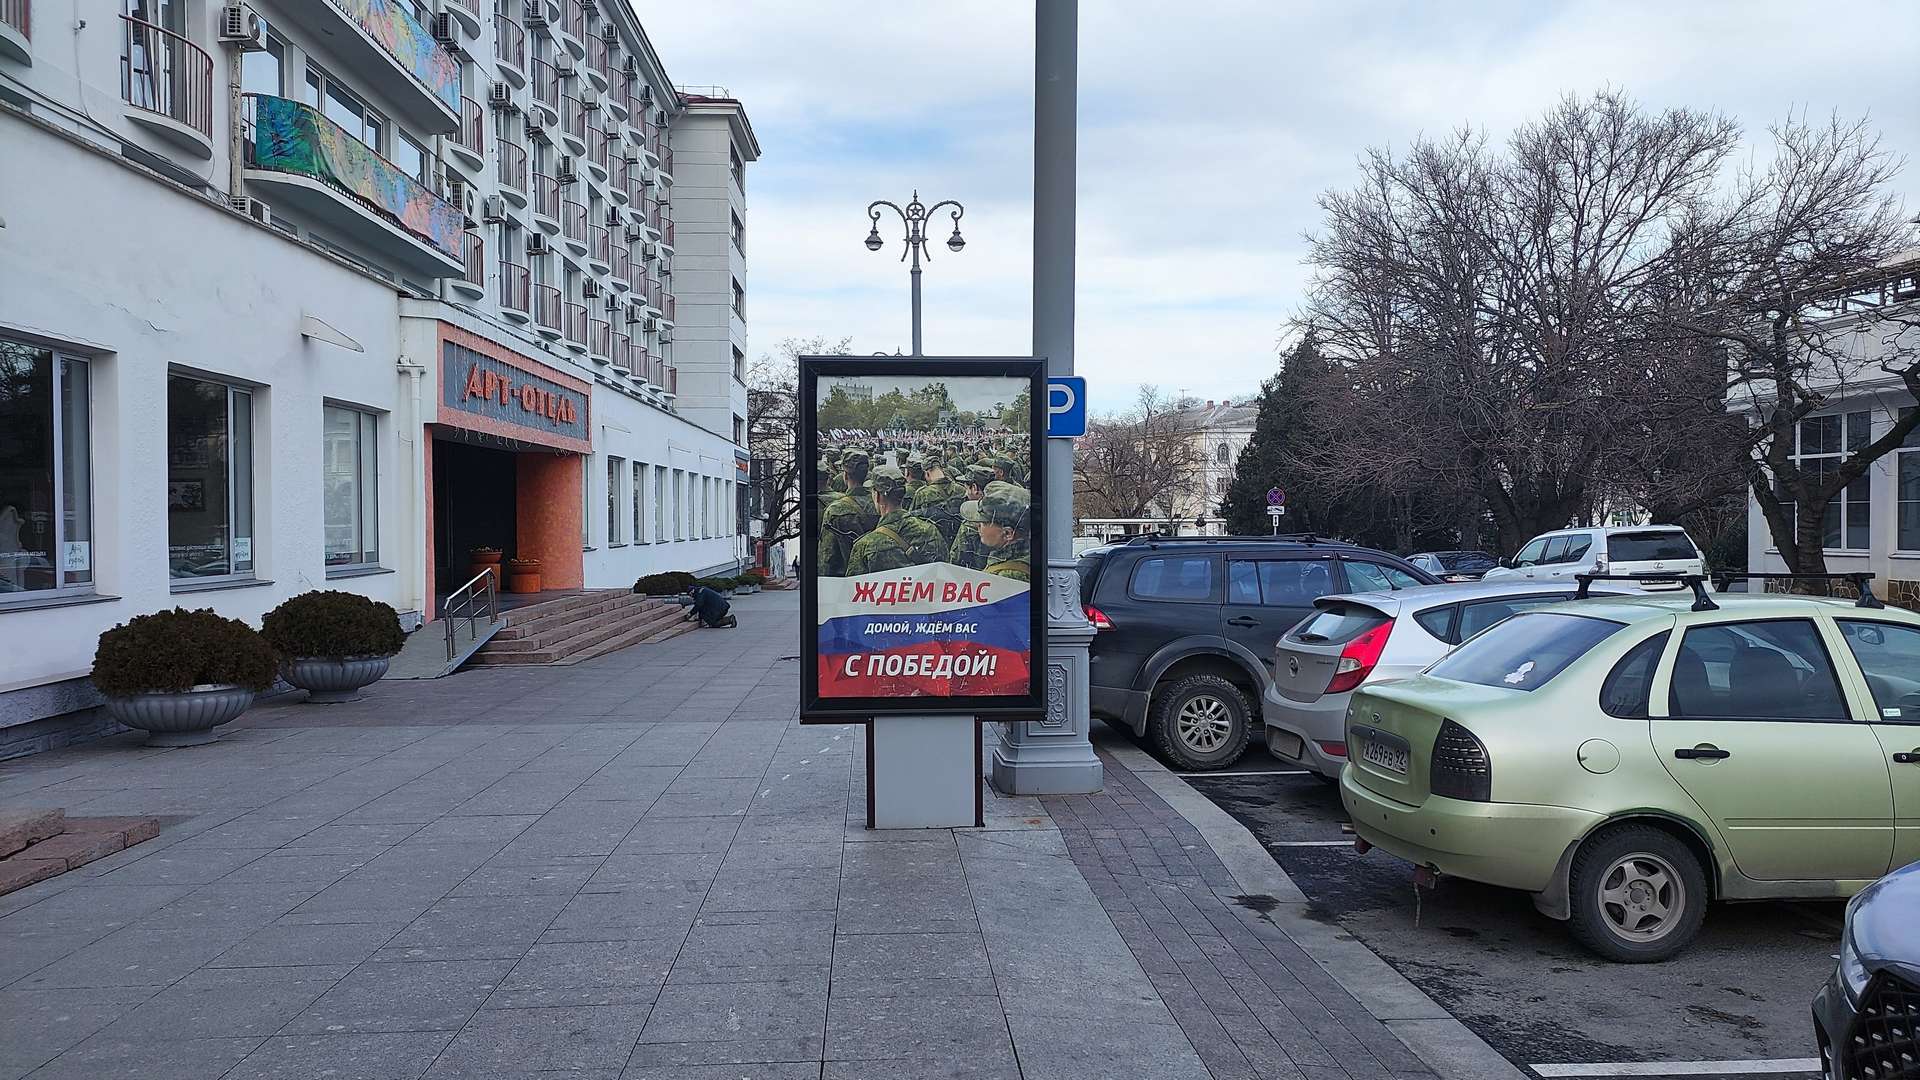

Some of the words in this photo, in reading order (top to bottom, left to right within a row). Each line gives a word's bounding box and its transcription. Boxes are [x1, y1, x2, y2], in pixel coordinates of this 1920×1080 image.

[463, 362, 577, 426] АРТ-ОТЕЛЬ
[1047, 383, 1075, 430] P
[852, 576, 935, 605] ЖДЁМ
[942, 582, 991, 603] ВАС
[864, 620, 912, 635] ДОМОЙ,
[915, 620, 957, 635] ЖДЁМ
[956, 622, 978, 634] ВАС
[845, 654, 862, 676] С
[866, 649, 998, 679] ПОБЕДОЙ!
